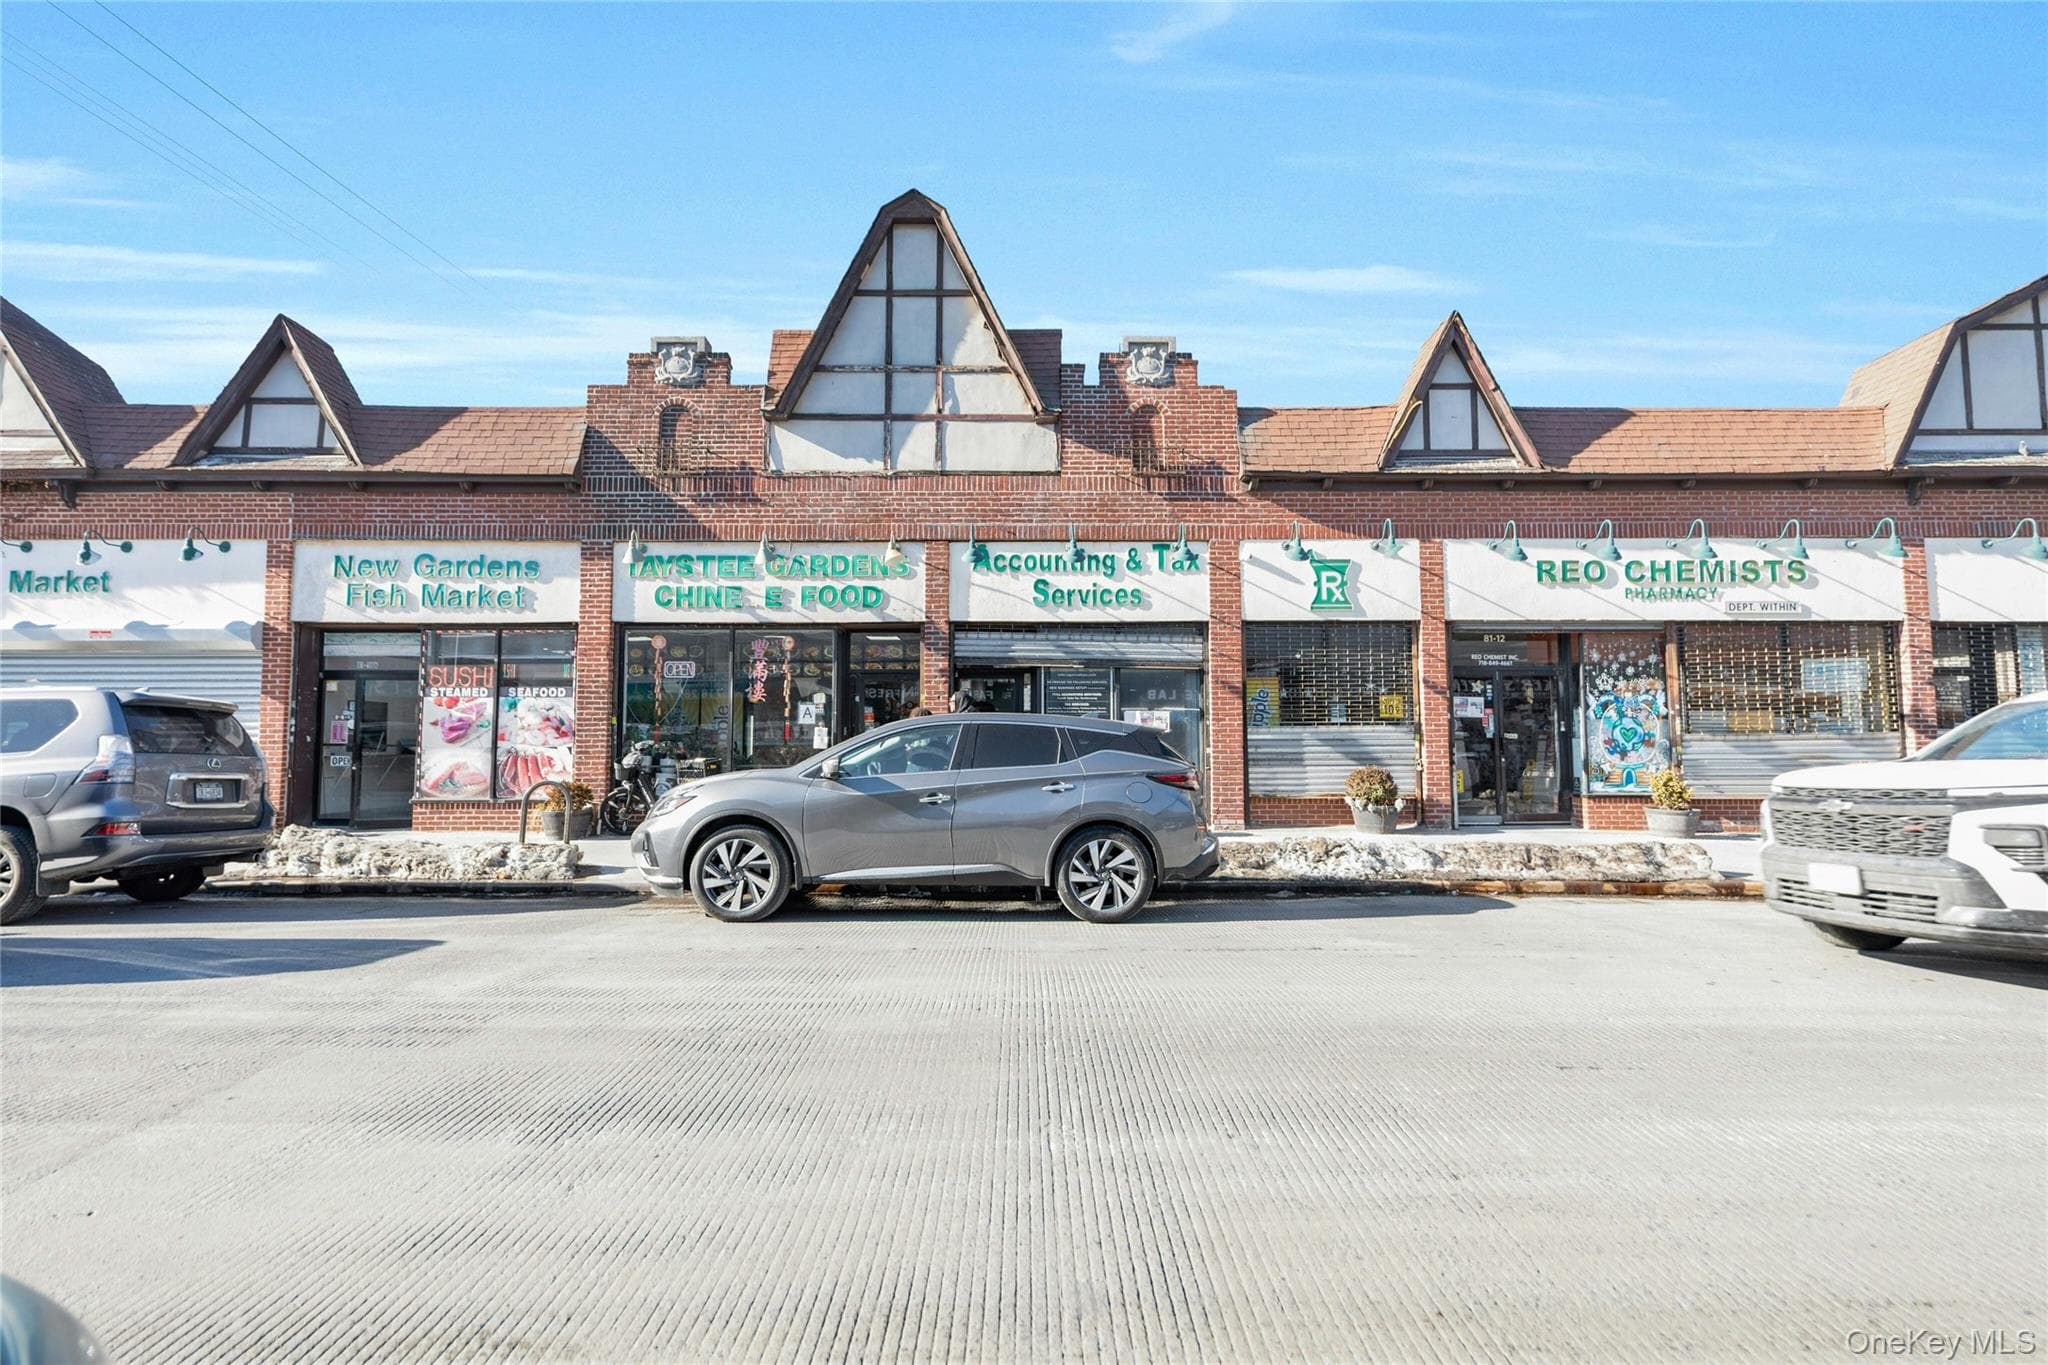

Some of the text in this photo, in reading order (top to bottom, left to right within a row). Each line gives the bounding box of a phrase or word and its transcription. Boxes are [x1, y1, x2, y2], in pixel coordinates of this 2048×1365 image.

[333, 553, 540, 579] New Gardens
[1126, 547, 1143, 571] &
[9, 569, 111, 593] Market
[1536, 559, 1807, 583] REO CHEMISTS
[346, 583, 526, 609] Fish Market
[654, 585, 743, 609] CHINE
[801, 584, 884, 609] FOOD
[1032, 578, 1143, 608] Services
[1624, 587, 1718, 600] PHARMACY
[1728, 602, 1798, 612] DEPT. WITHIN
[429, 665, 495, 688] SUSHI
[666, 663, 694, 676] OPEN
[430, 687, 489, 697] STEAMED
[508, 687, 567, 697] SEAFOOD
[802, 706, 813, 719] A
[331, 756, 351, 766] OPE
